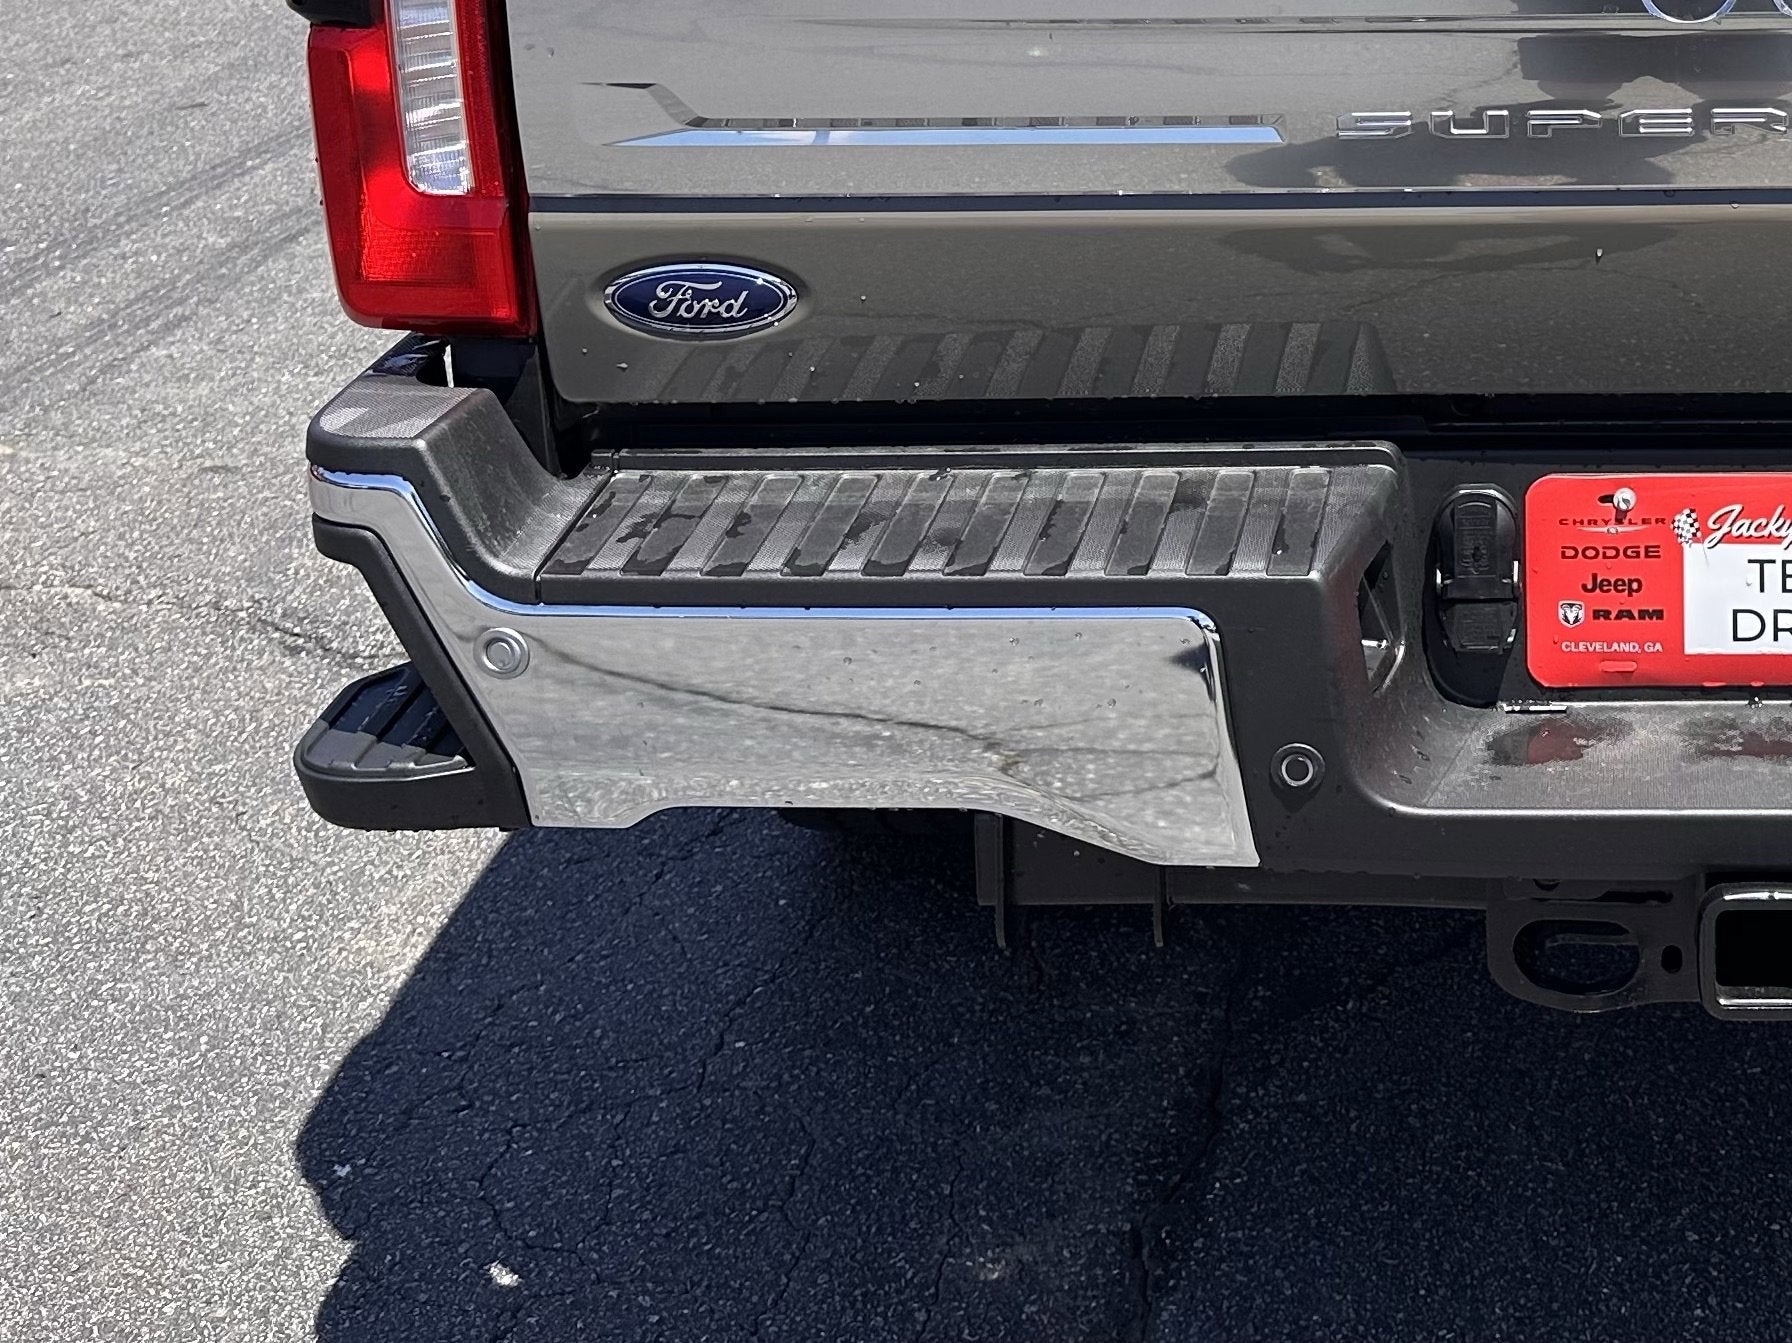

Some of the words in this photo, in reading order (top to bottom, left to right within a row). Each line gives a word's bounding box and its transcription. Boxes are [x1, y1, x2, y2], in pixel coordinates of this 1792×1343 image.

[1336, 106, 1788, 141] SUPER
[649, 280, 749, 319] Ford
[1560, 544, 1662, 561] DODGE
[1580, 572, 1643, 597] Jeep
[1591, 609, 1665, 622] RAM
[1561, 641, 1642, 654] CLEVELAND,
[1643, 641, 1664, 654] GA
